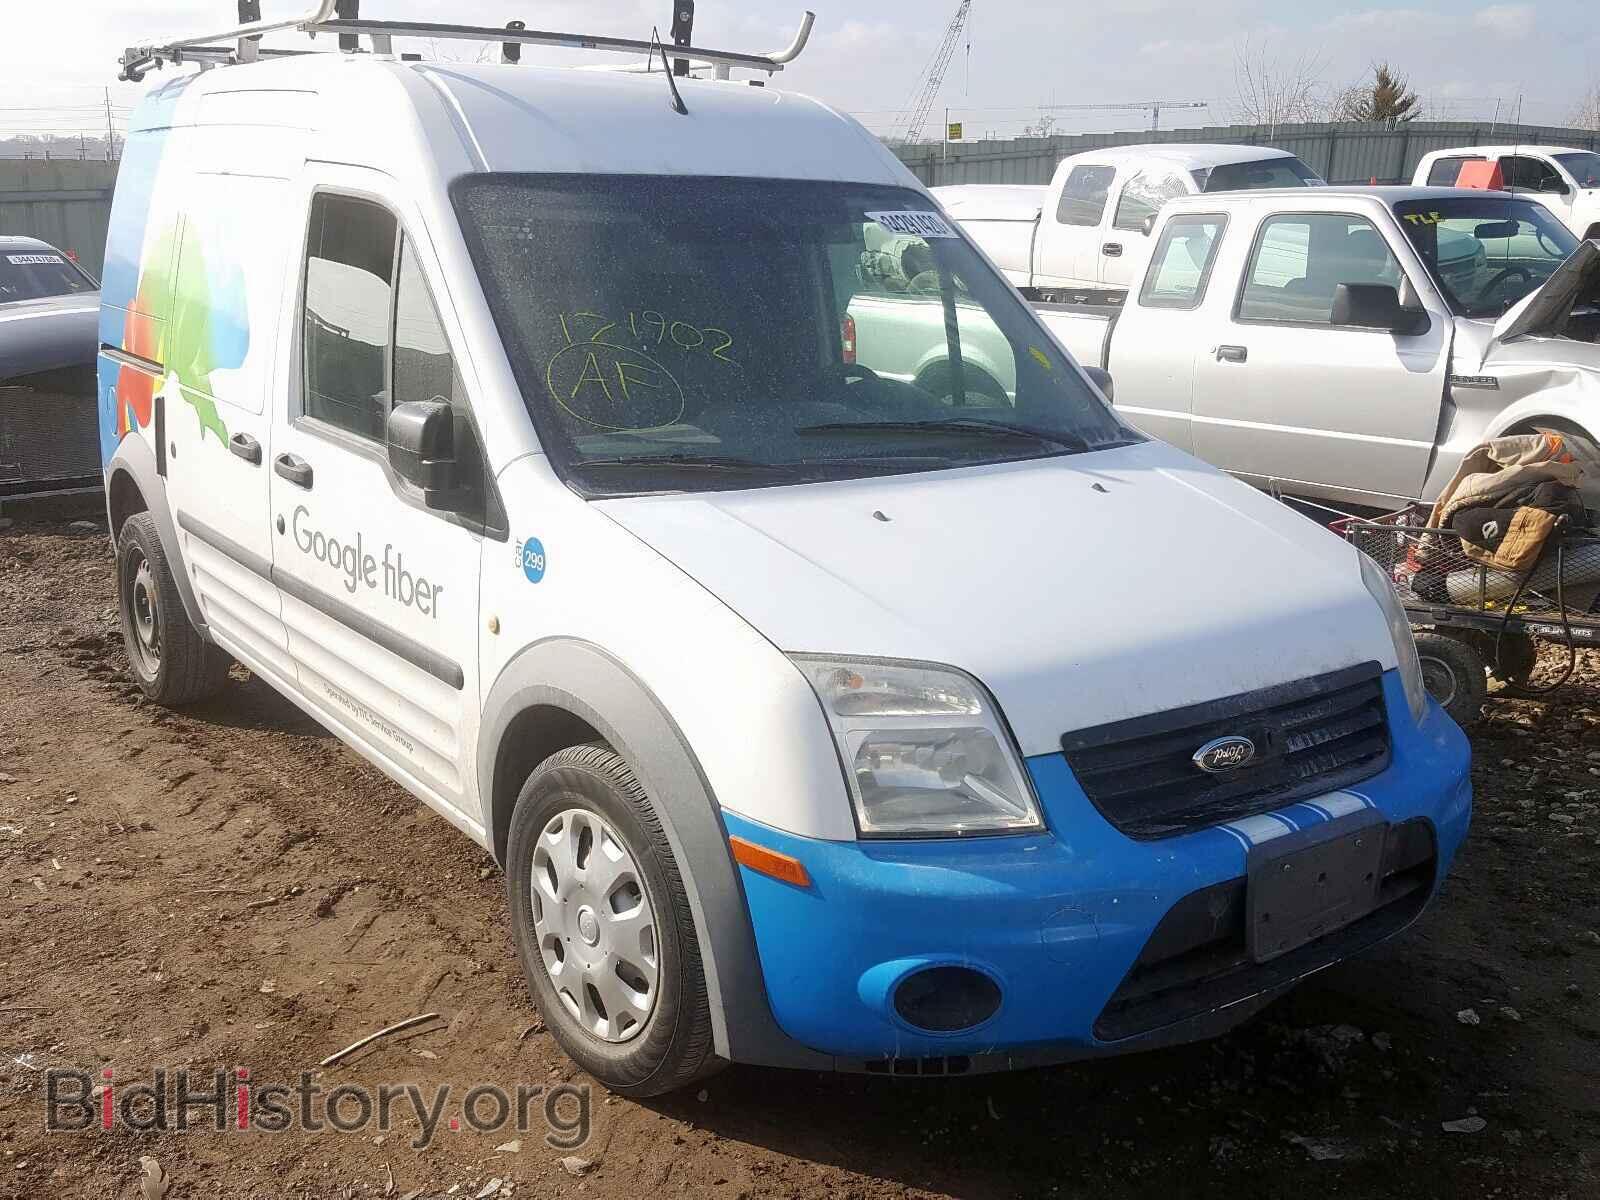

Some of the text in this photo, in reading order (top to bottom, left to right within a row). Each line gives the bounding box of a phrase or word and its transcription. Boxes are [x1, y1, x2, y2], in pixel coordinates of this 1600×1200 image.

[293, 505, 443, 619] Google fiber
[525, 550, 543, 570] 299
